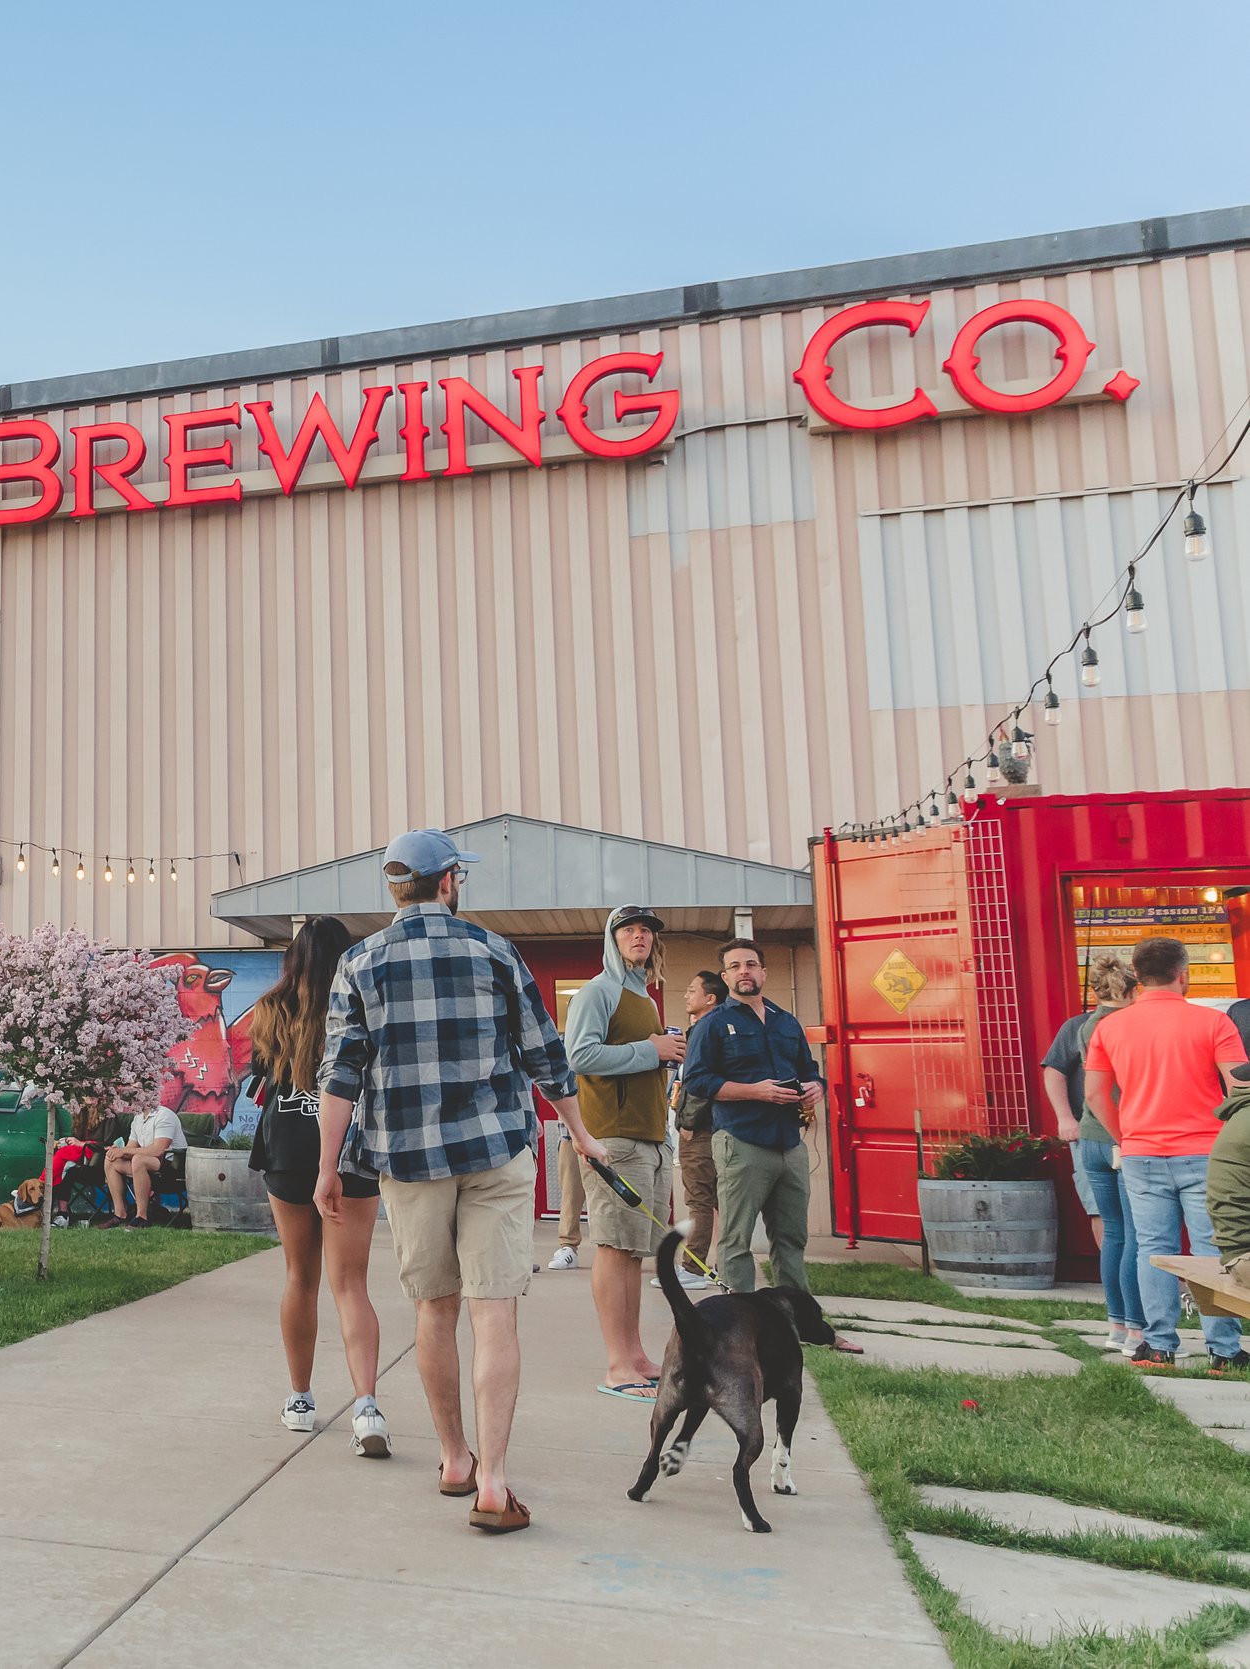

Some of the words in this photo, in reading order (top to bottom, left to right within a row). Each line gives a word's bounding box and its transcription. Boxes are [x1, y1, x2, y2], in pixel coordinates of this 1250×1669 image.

[793, 300, 1141, 433] CO.
[1108, 908, 1145, 918] CHOP
[1201, 906, 1225, 914] IPA
[1112, 928, 1142, 937] DAZE
